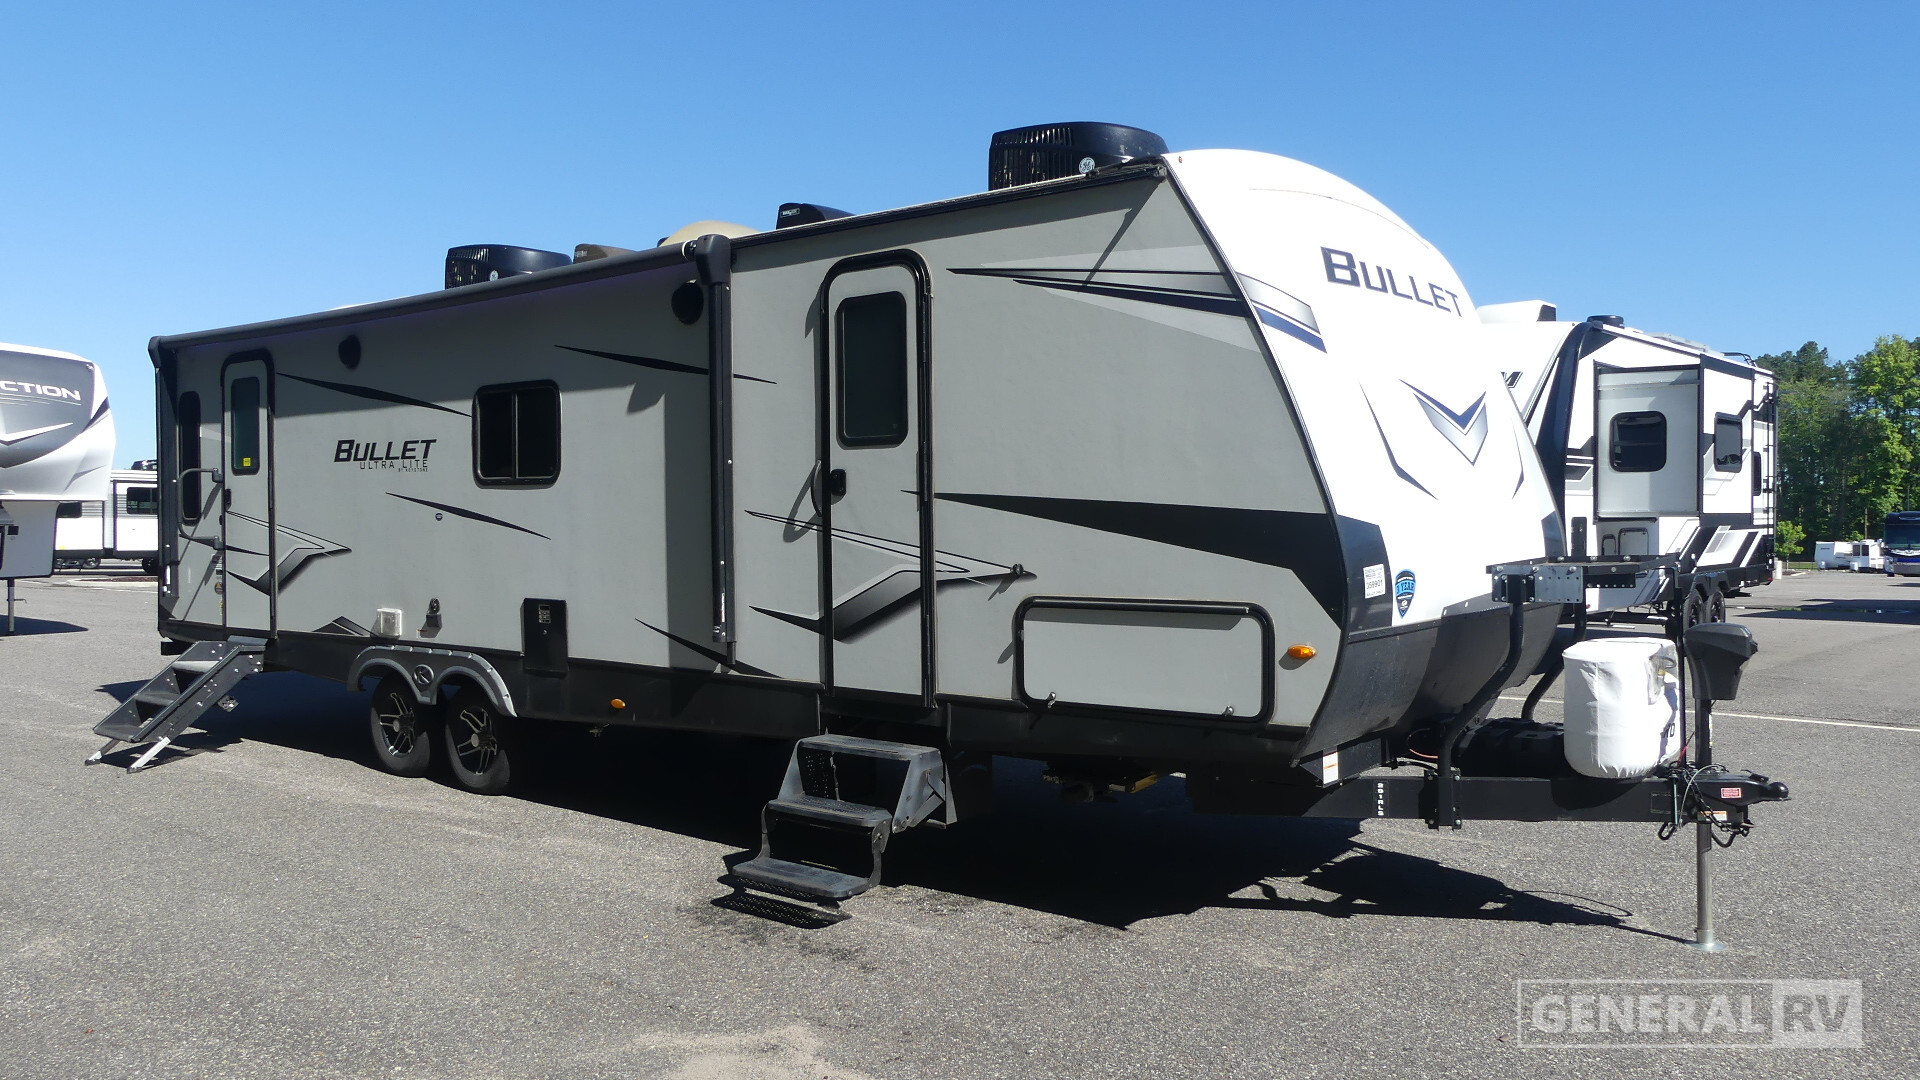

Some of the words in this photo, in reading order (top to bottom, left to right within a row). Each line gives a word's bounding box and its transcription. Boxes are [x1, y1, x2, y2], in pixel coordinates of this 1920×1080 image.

[1320, 246, 1462, 318] BULLET
[0, 380, 81, 401] CTION
[334, 439, 437, 462] BULLET
[360, 461, 395, 470] ULTRA
[402, 460, 428, 469] LITE
